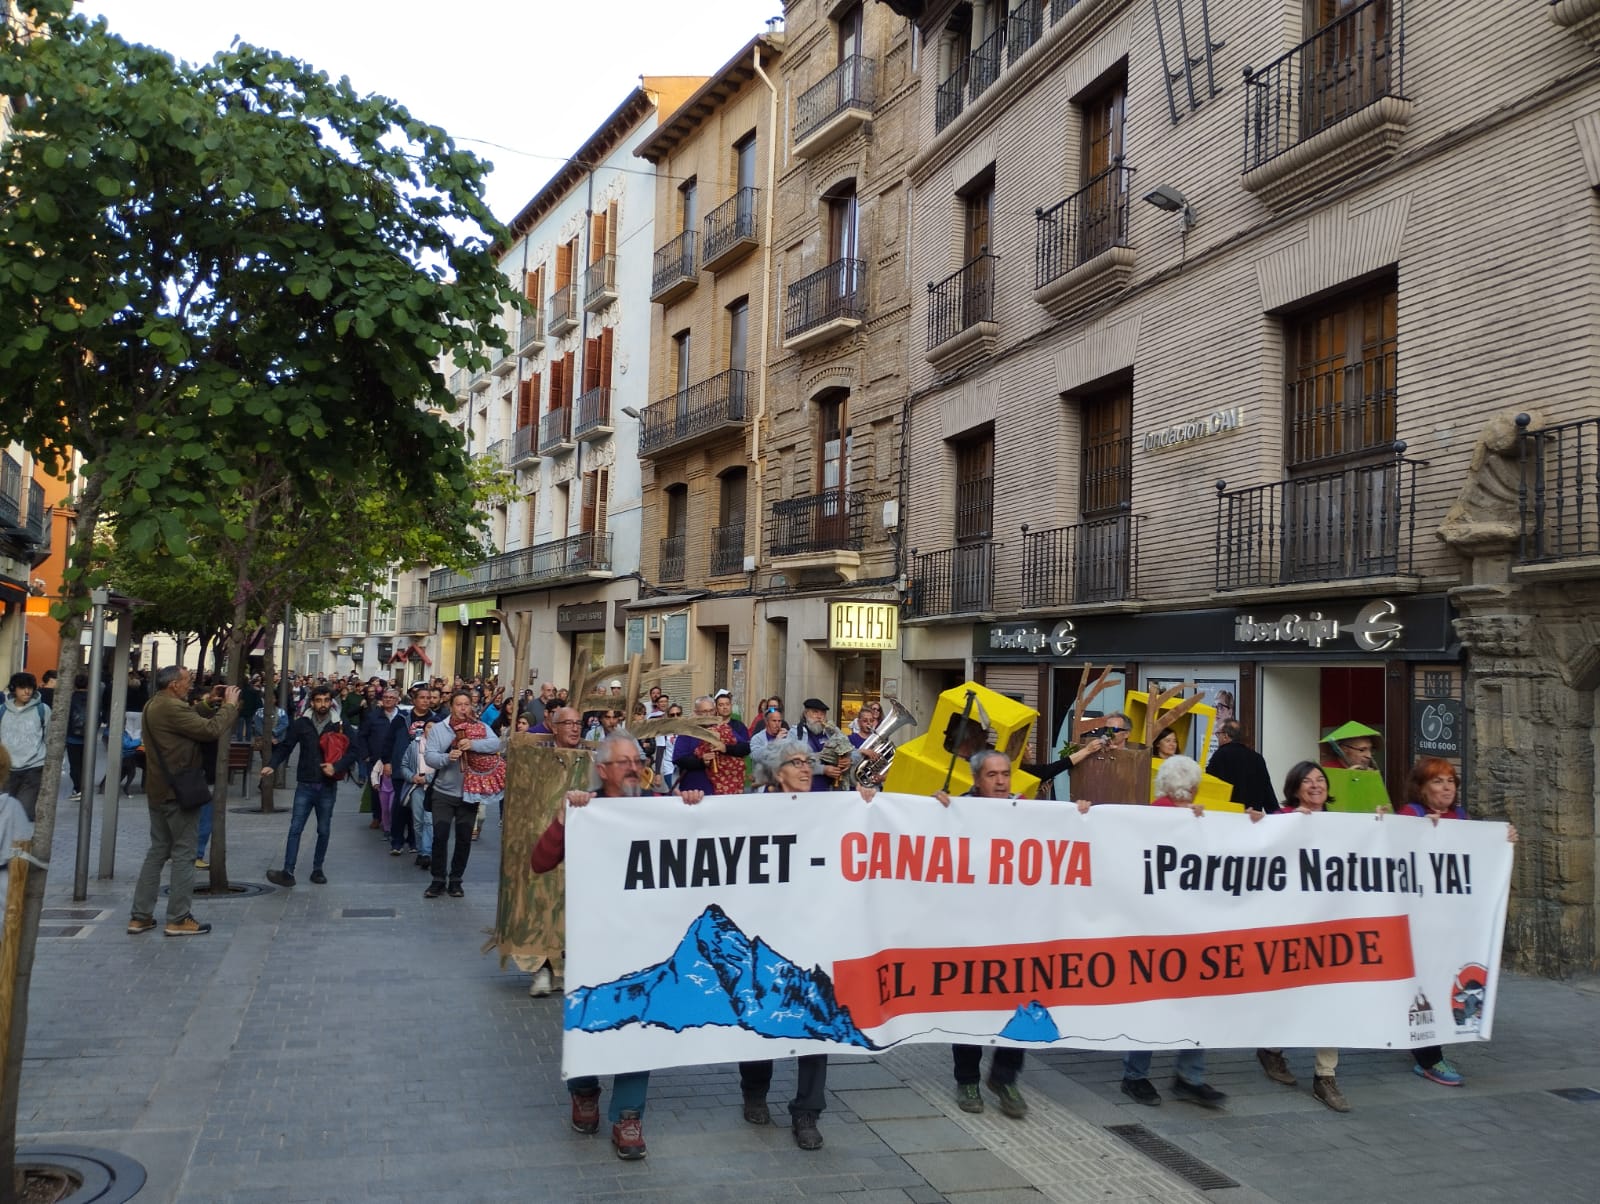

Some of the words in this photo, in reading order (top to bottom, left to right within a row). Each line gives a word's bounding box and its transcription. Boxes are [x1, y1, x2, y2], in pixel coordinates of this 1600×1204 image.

[1208, 407, 1243, 433] CAI
[836, 605, 893, 640] ASCASO
[1420, 741, 1437, 750] EURO
[1438, 742, 1456, 751] 6000
[625, 835, 797, 890] ANAYET
[810, 857, 825, 866] -
[841, 832, 975, 884] CANAL
[989, 838, 1091, 886] ROYA
[1143, 844, 1288, 897] ¡Parque
[1299, 847, 1424, 898] Natural,
[1429, 851, 1472, 895] YA!
[876, 961, 917, 1006] EL
[930, 951, 1117, 996] PIRINEO
[1129, 947, 1188, 985] NO
[1199, 942, 1244, 981] SE
[1254, 929, 1383, 975] VENDE
